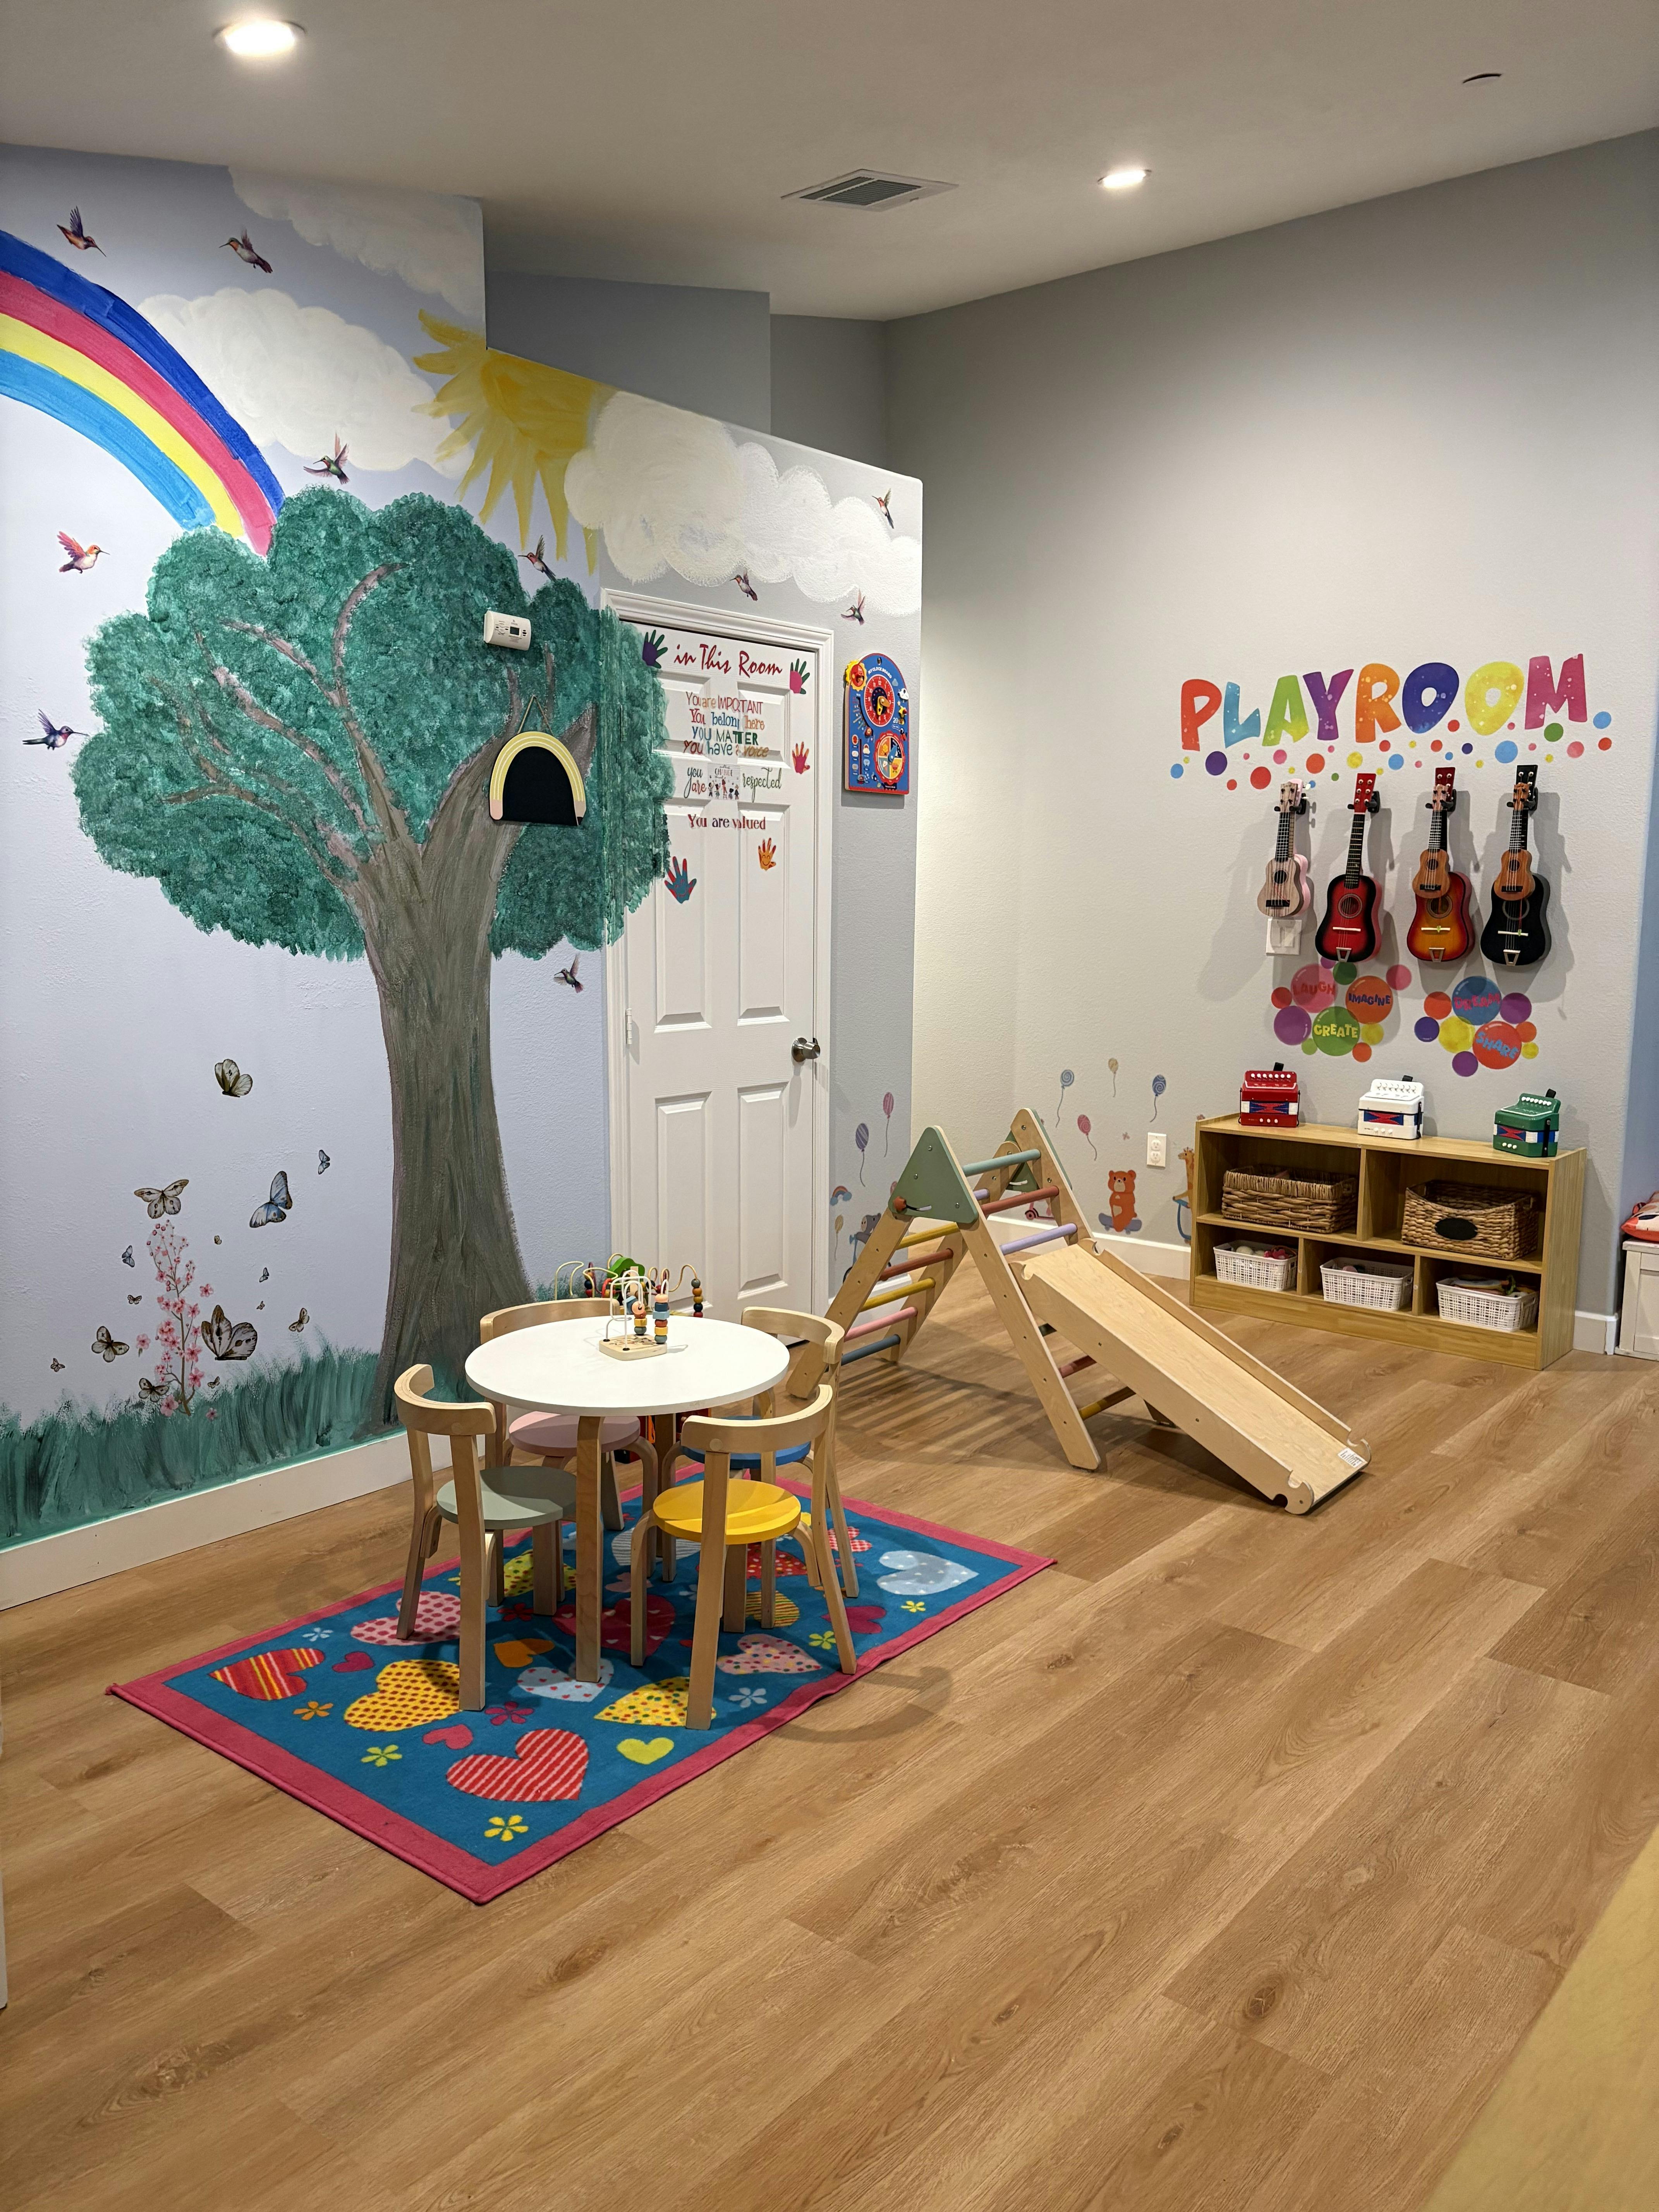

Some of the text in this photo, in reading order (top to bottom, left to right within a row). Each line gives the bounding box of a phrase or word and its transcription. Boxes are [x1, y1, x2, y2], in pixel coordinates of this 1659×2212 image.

[674, 644, 782, 678] in This Room
[882, 668, 892, 678] BOARD
[702, 697, 716, 708] are
[718, 695, 764, 714] IMPOTANT
[1181, 653, 1587, 751] PLAYROOM
[743, 715, 765, 730] here
[716, 728, 759, 745] MATTER
[708, 741, 733, 756] have
[684, 767, 782, 803] you are respected
[712, 817, 730, 828] are
[1292, 981, 1336, 996] LAUGH
[1348, 993, 1391, 1006] IMAGINE
[1453, 993, 1500, 1011] DREAM
[1314, 1024, 1358, 1038] CREATE
[1475, 1031, 1519, 1059] SHARE
